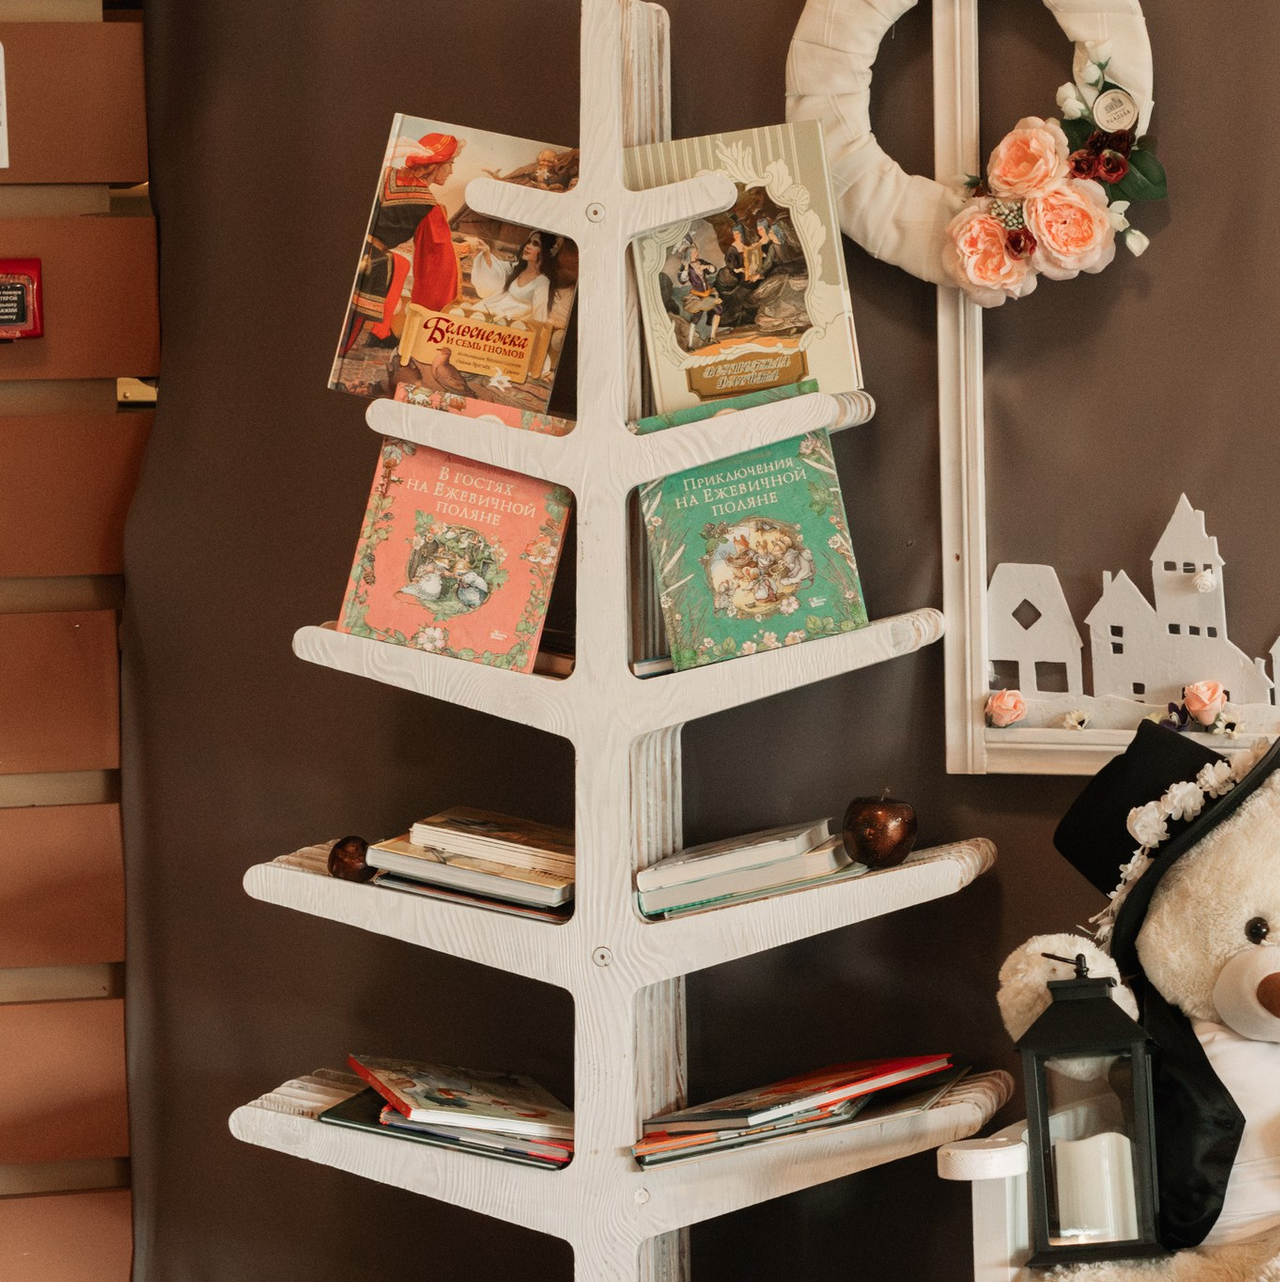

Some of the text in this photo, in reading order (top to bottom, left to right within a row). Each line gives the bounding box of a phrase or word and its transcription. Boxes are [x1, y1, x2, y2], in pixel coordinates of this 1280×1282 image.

[423, 317, 529, 349] Белоснежка
[446, 336, 525, 359] И СЕМЬ ГНОМОВ
[438, 466, 450, 481] В
[454, 473, 515, 496] ГОСТЯХ
[675, 467, 807, 509] НА ЕЖЕВИЧНОЙ
[682, 457, 794, 491] ПРИКЛЮЧЕНИЯ
[406, 478, 537, 518] НА ЕЖЕВИЧНОЙ
[712, 492, 778, 517] ПОЛЯНЕ
[436, 502, 501, 526] ПОЛЯНЕ
